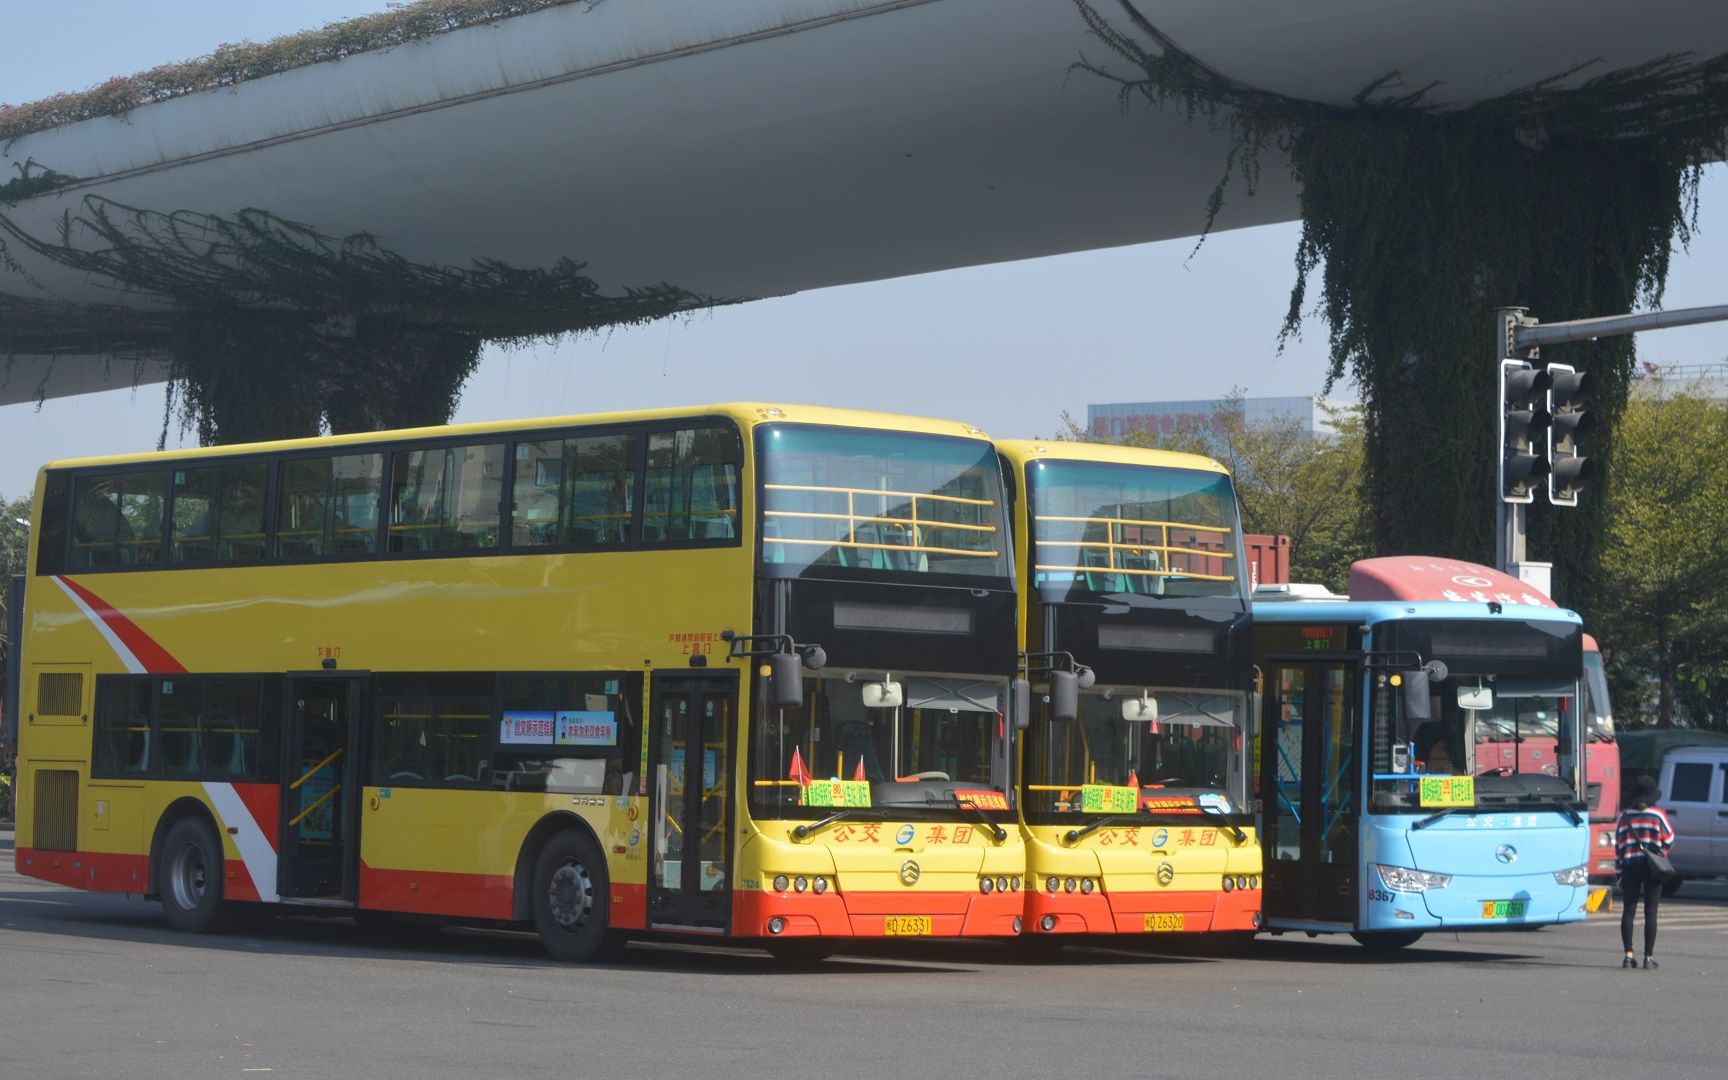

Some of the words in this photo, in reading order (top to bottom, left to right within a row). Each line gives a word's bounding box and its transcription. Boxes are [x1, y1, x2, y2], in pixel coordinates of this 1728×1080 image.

[833, 822, 881, 843] 公交
[926, 825, 974, 845] 集团
[1099, 828, 1139, 846] 公交
[1177, 829, 1217, 846] 集团
[1368, 889, 1395, 903] 8367
